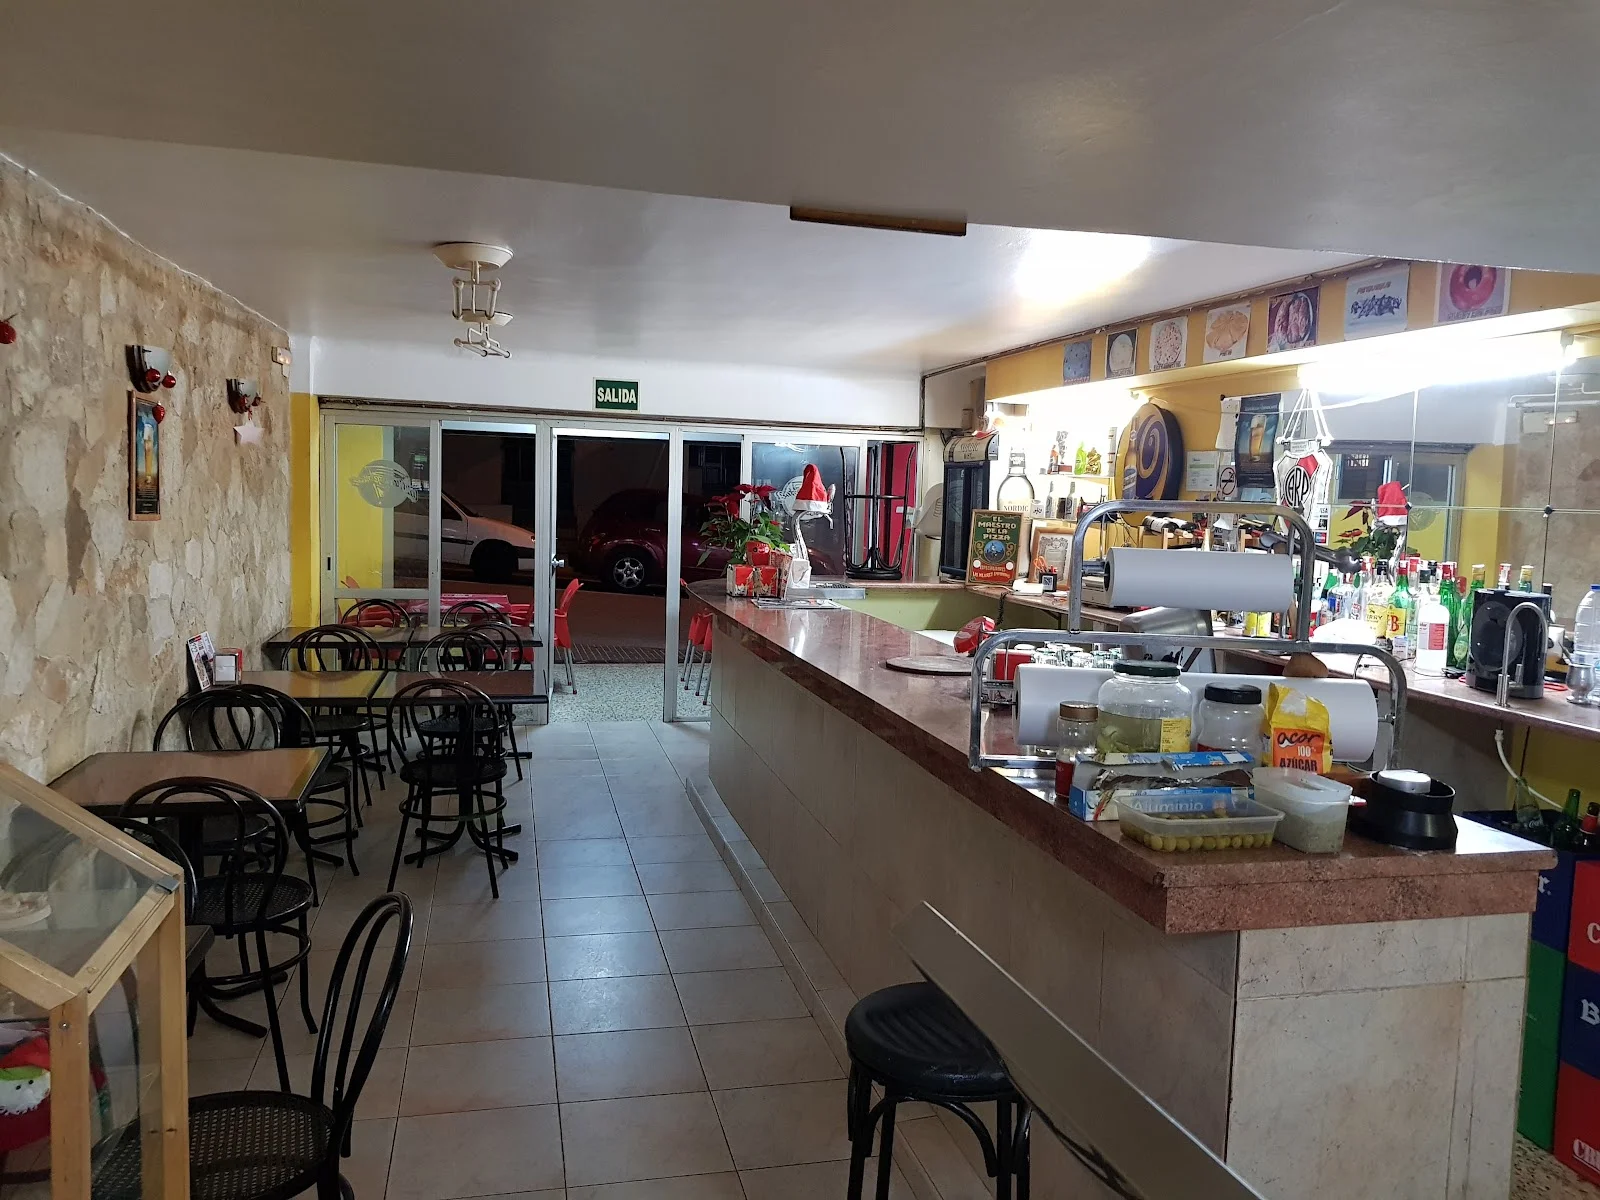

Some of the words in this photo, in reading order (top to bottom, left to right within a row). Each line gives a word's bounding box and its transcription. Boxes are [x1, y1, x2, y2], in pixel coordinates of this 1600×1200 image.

[597, 387, 637, 404] SALIDA
[978, 521, 1017, 530] MAESTRO
[982, 533, 1010, 541] PIZZA
